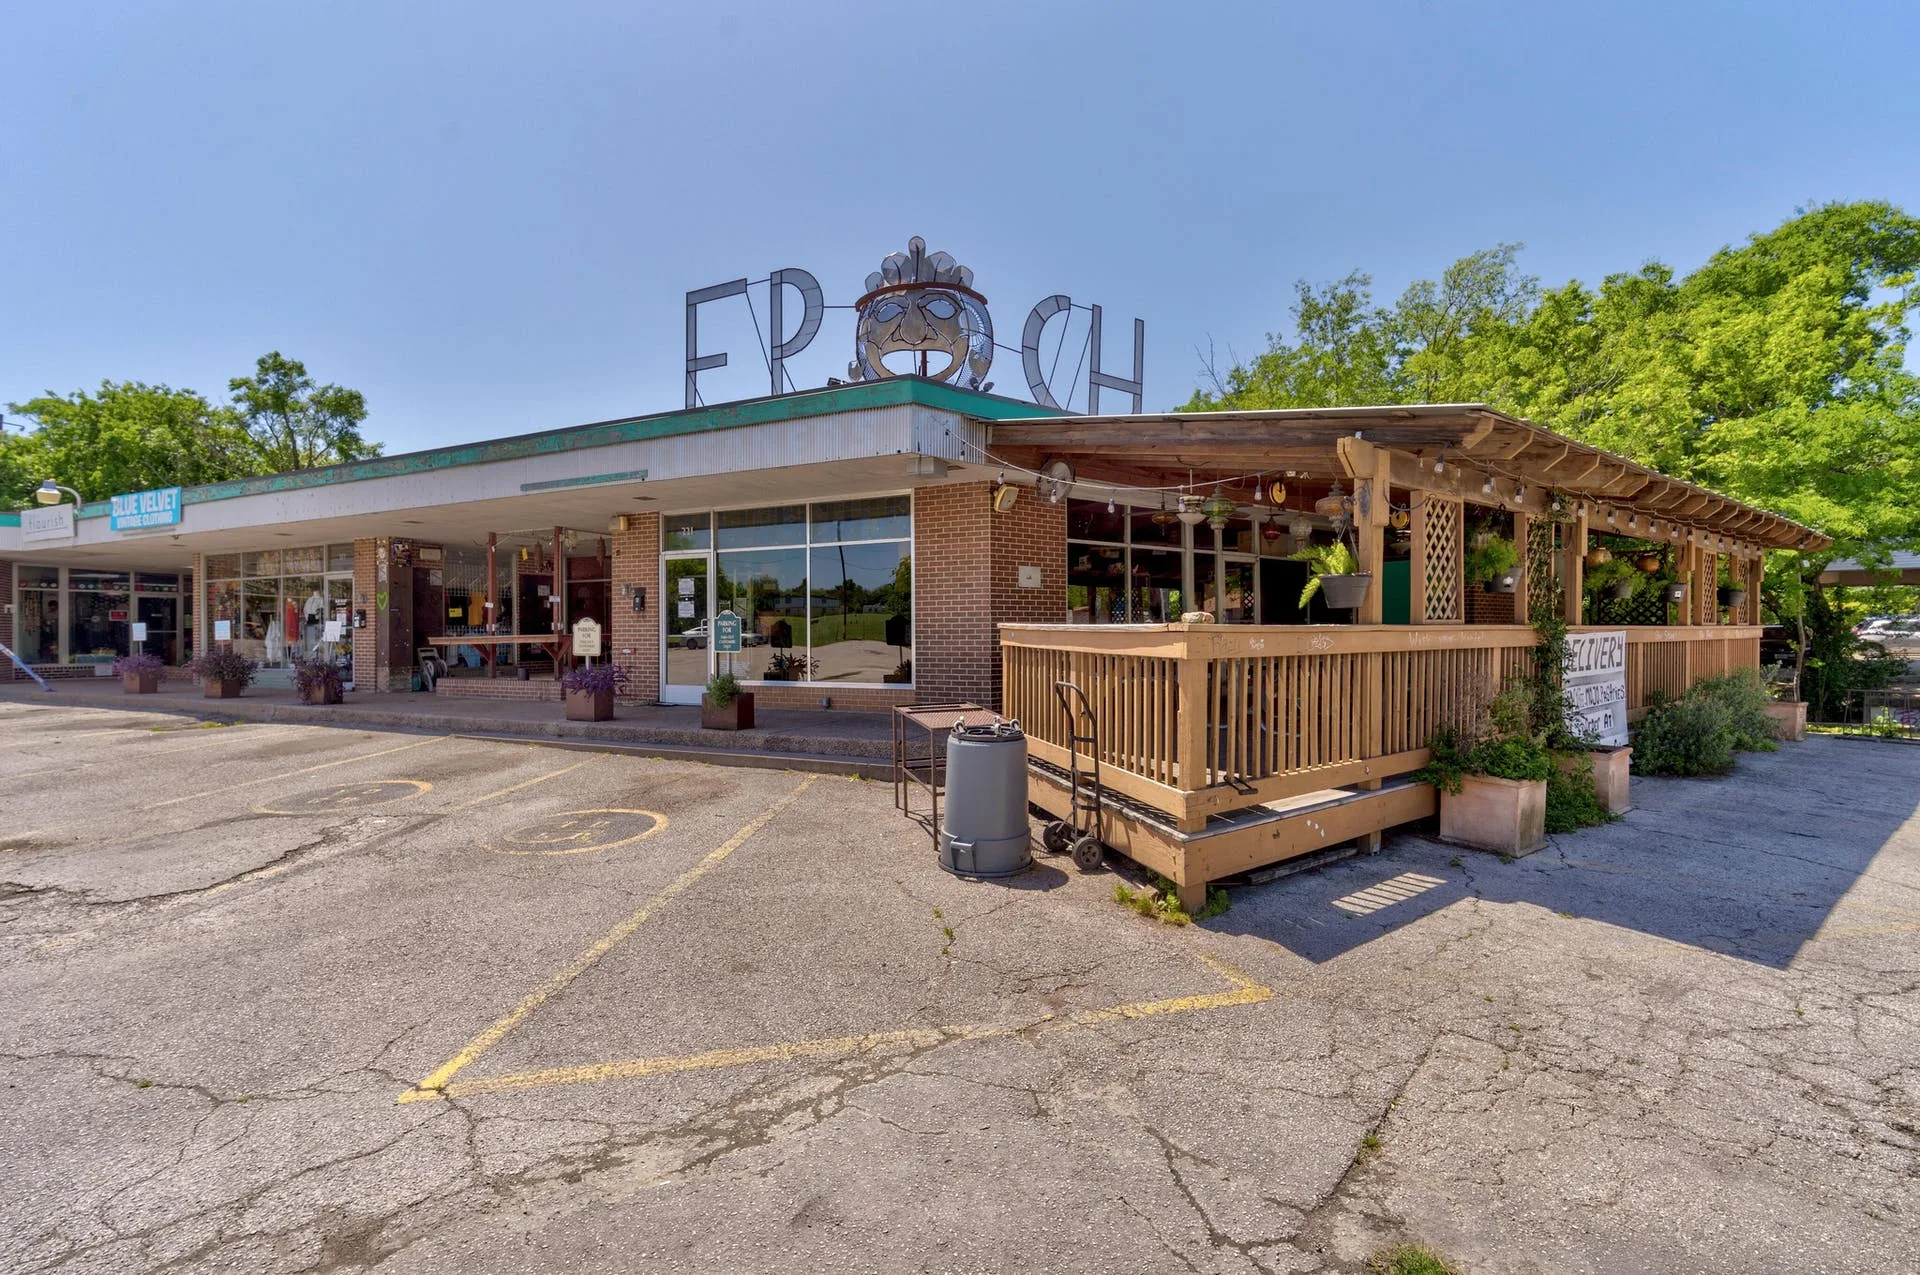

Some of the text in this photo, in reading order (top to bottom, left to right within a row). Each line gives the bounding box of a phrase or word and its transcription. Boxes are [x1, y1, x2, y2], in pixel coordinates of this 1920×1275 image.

[111, 488, 178, 517] BLUE VELVET
[717, 620, 737, 628] PARKING
[1564, 636, 1624, 672] DELIVERY
